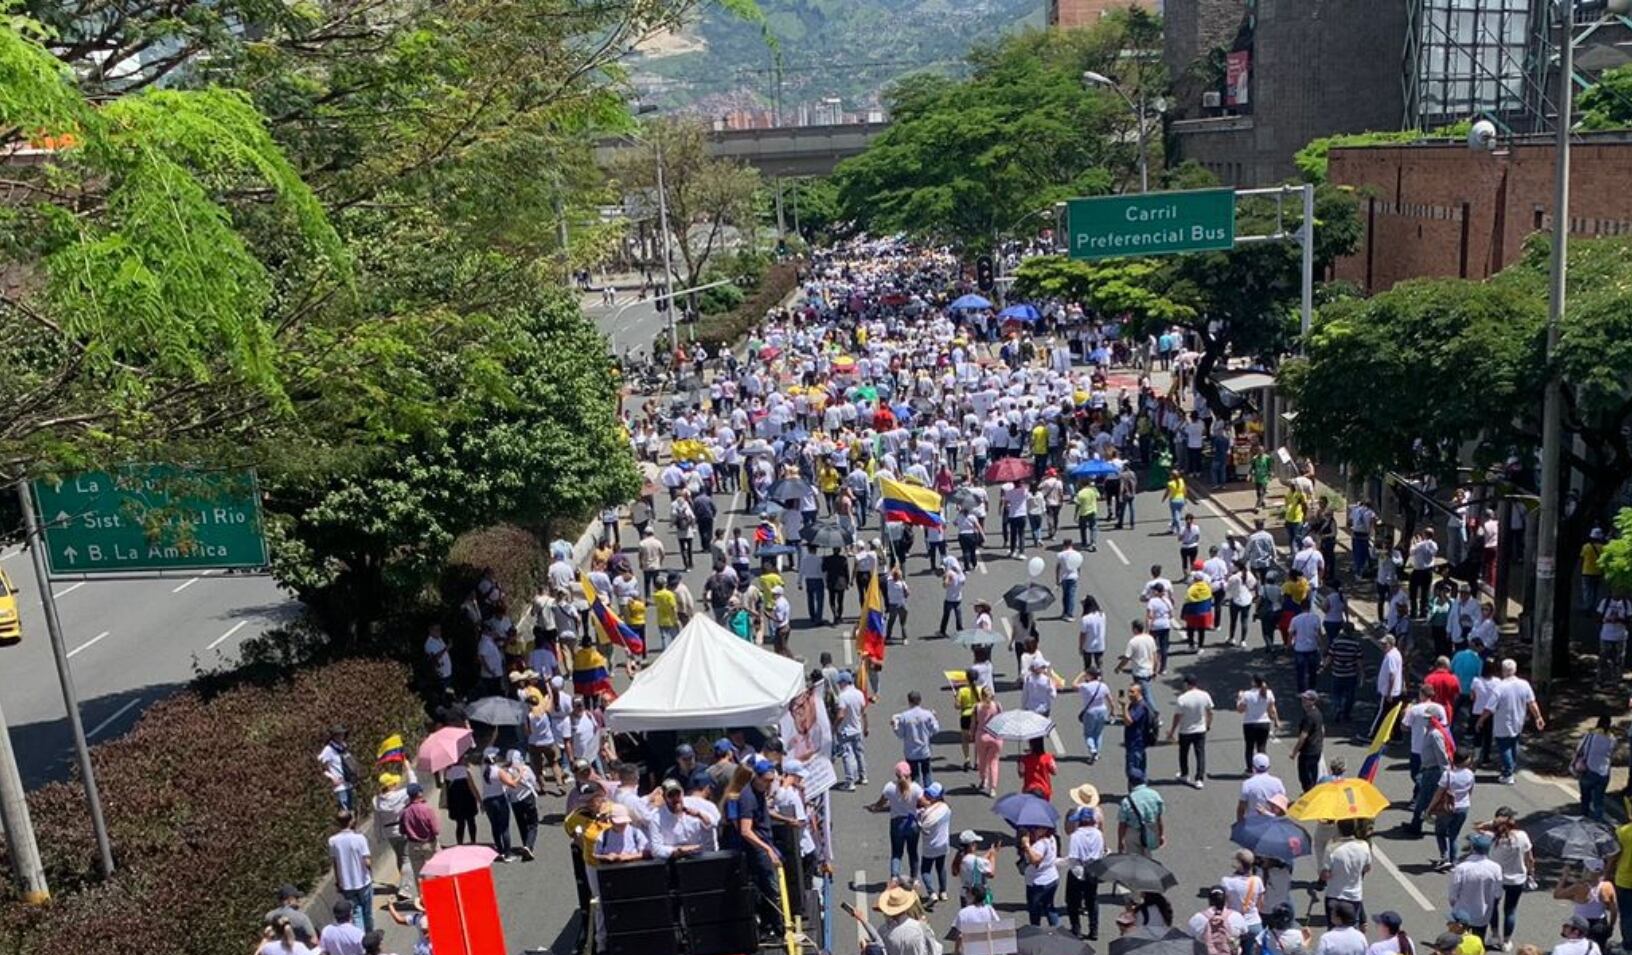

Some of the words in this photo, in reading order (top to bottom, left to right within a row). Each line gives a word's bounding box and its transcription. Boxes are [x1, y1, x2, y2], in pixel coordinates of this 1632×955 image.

[1125, 205, 1177, 221] Carril
[1077, 229, 1184, 249] Preferencial
[1191, 226, 1226, 241] Bus
[76, 477, 99, 493] La
[88, 545, 108, 561] B.
[115, 545, 139, 560] La
[147, 542, 229, 560] Amrica
